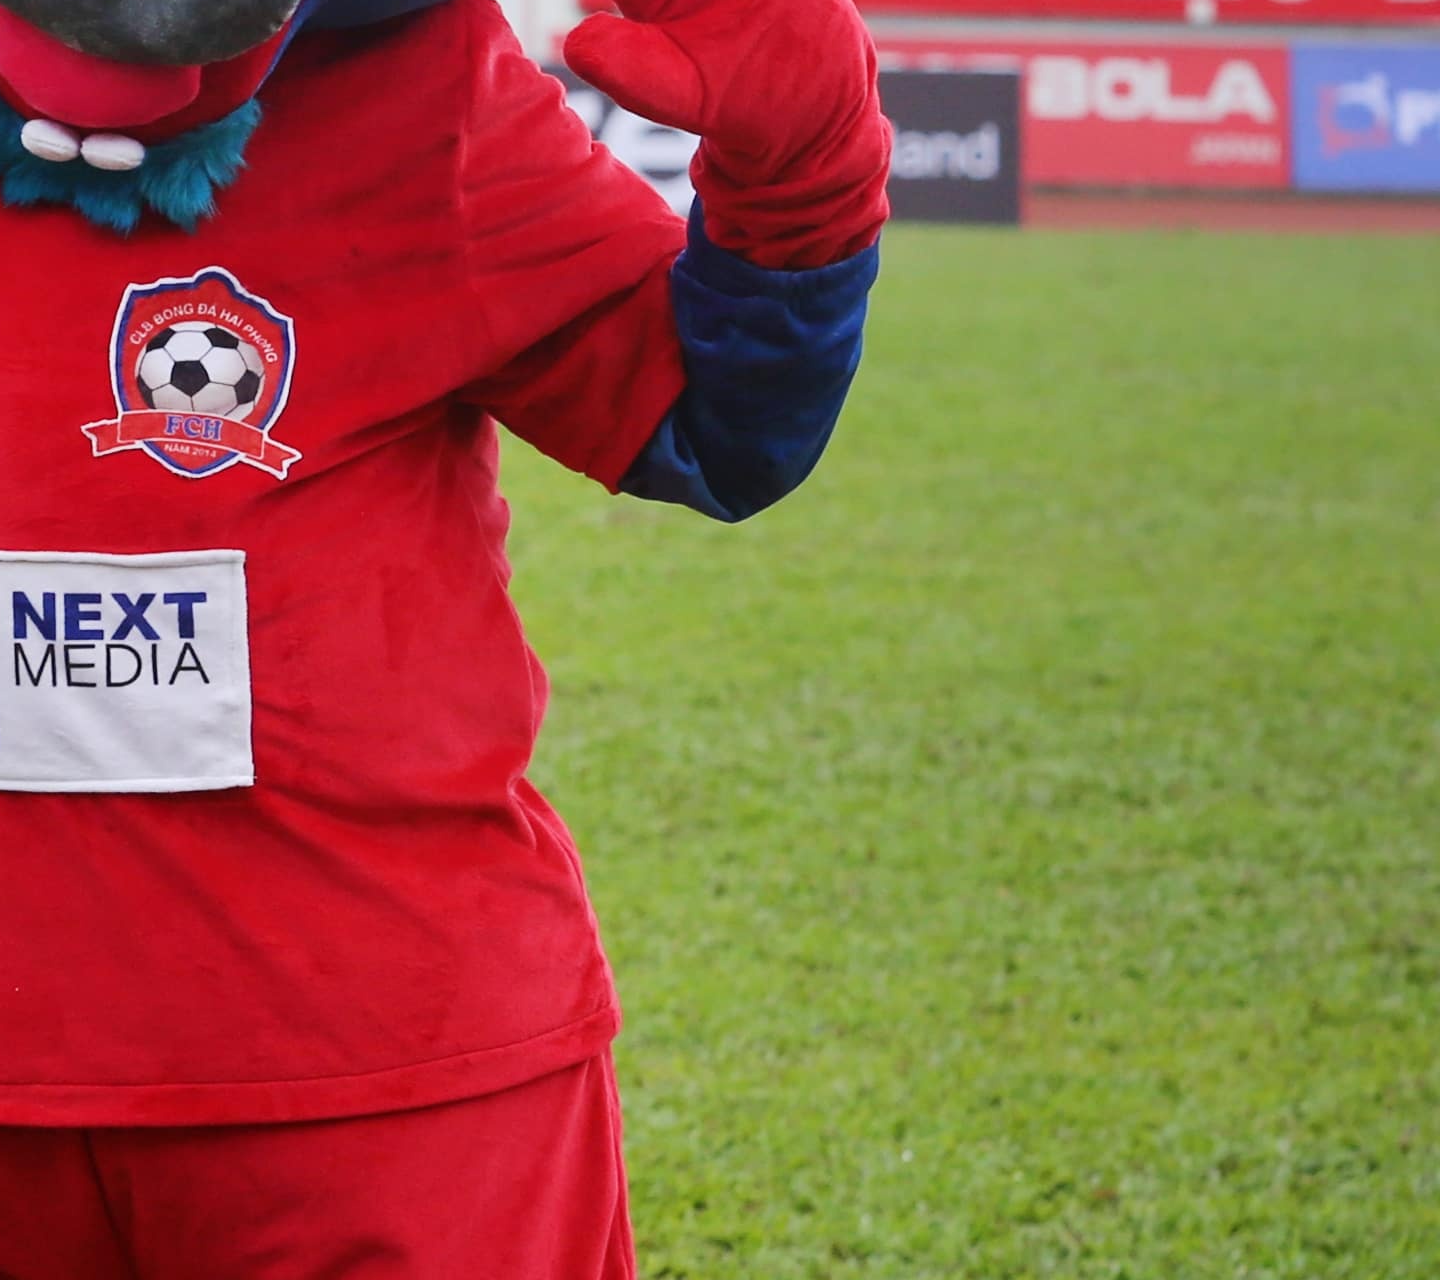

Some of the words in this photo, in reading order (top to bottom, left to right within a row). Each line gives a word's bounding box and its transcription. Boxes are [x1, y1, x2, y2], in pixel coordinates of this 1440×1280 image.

[163, 414, 224, 442] FCH
[12, 590, 208, 641] NEXT
[13, 642, 211, 689] MEDIA
